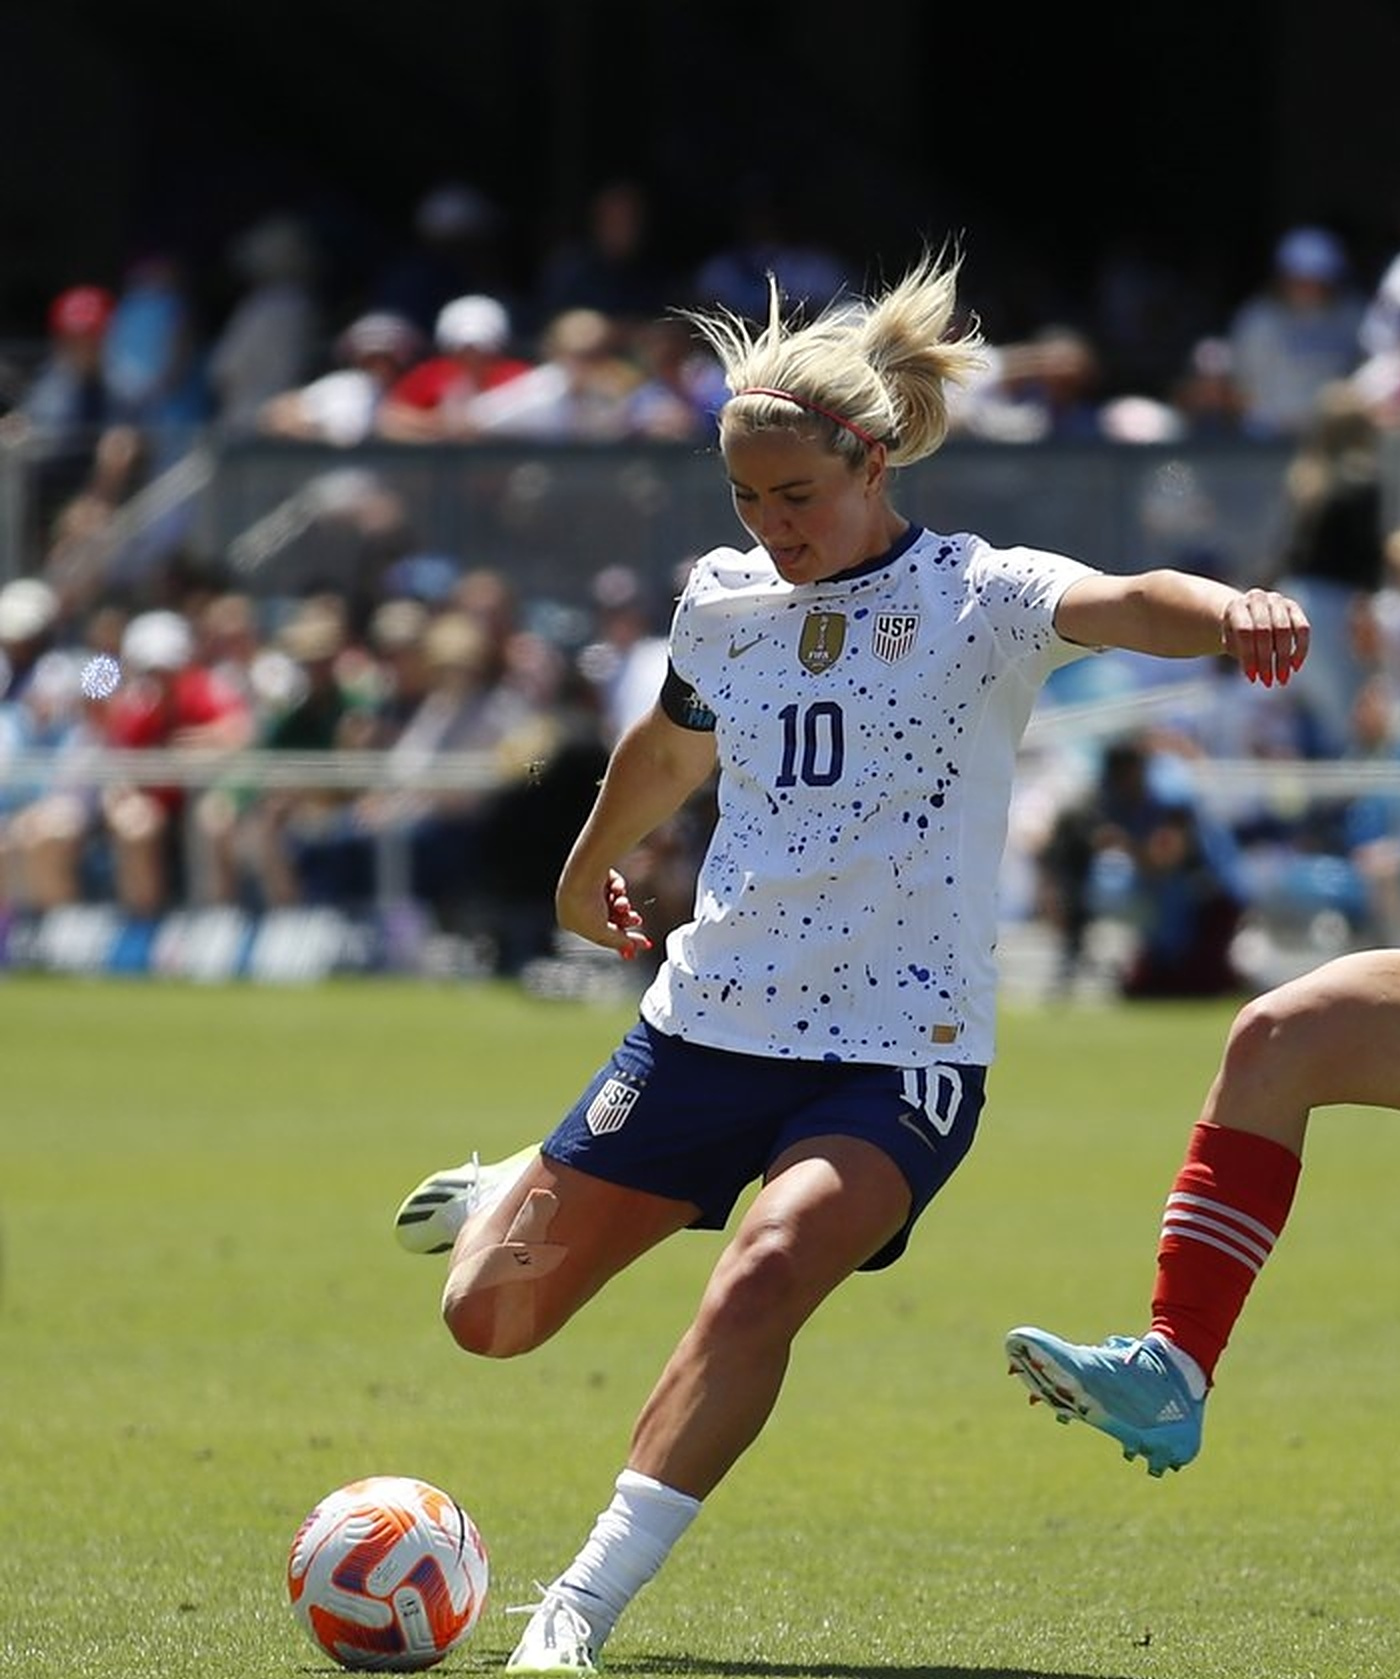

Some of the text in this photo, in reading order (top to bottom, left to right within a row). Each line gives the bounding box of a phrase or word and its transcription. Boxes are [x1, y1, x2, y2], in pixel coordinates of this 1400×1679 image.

[879, 616, 916, 637] USA
[775, 701, 845, 787] 10
[603, 1081, 637, 1106] USA
[899, 1064, 963, 1136] 10
